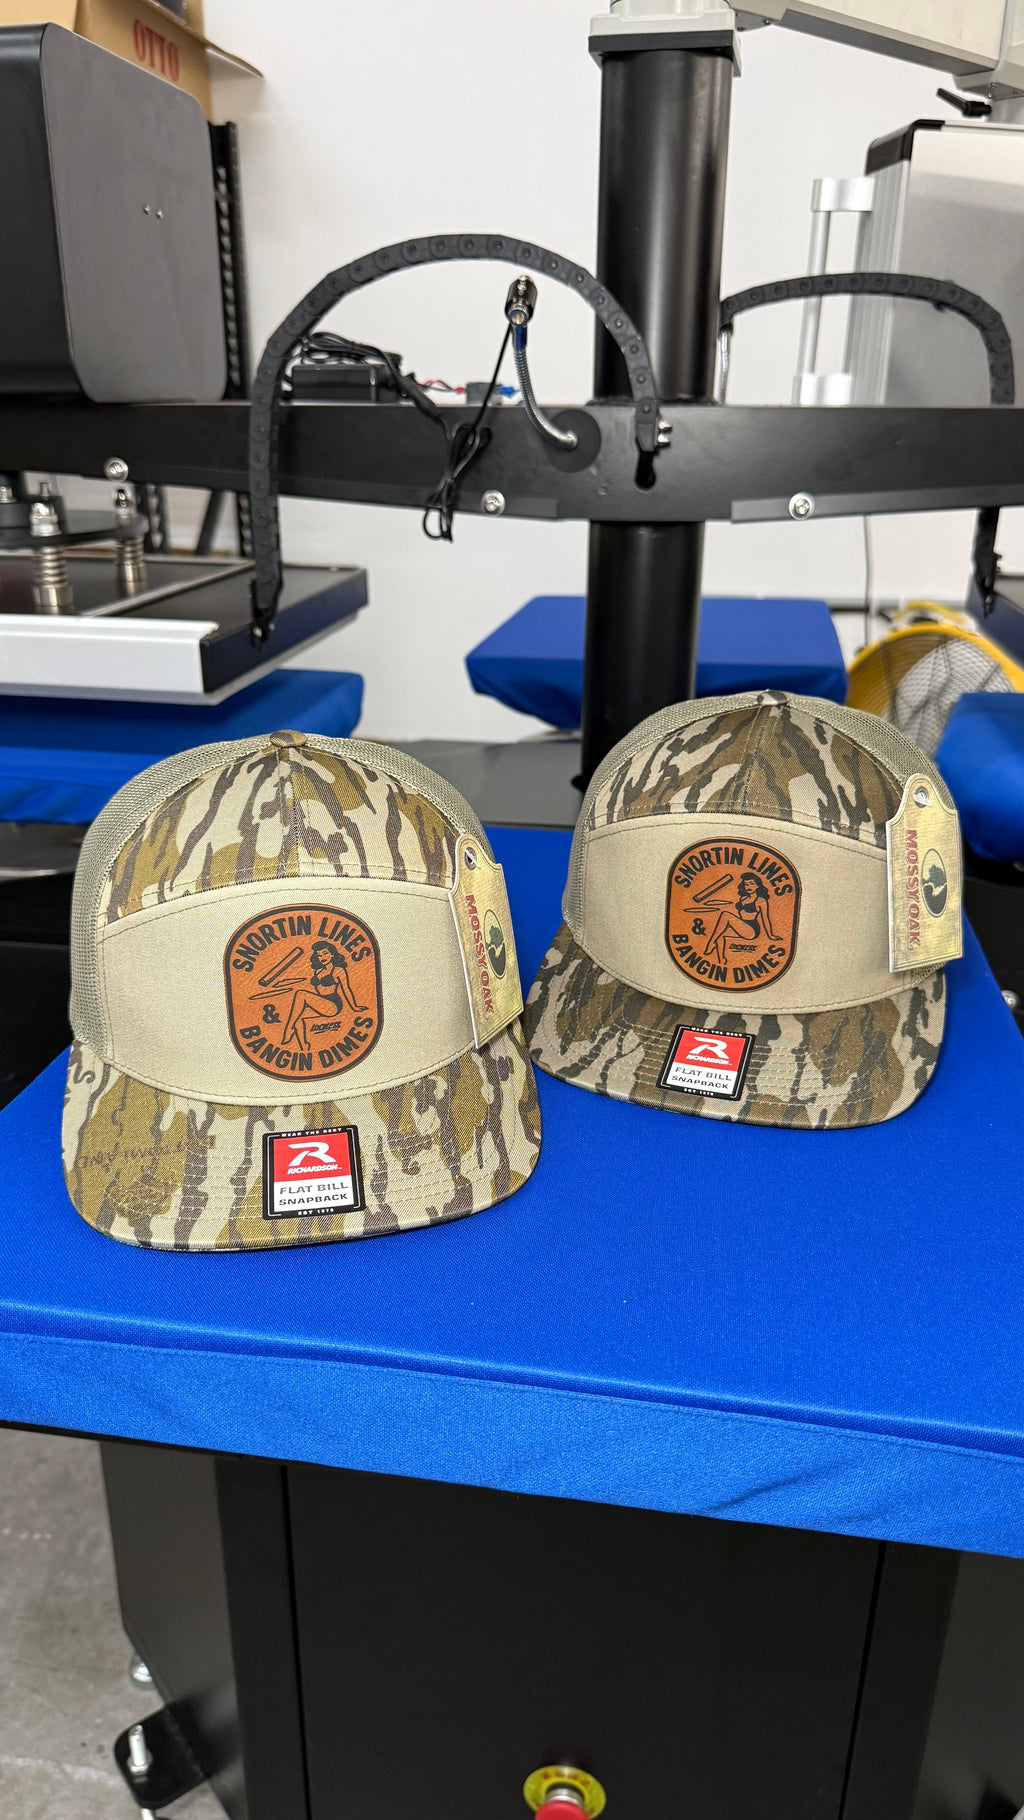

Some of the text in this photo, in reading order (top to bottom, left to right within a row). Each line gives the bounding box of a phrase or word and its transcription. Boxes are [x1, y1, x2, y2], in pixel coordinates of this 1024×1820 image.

[134, 19, 180, 82] OTTO
[674, 847, 793, 897] SNORTIN LINES
[905, 829, 921, 946] MOSSY OAK
[691, 918, 706, 937] &
[232, 915, 372, 973] SNORTIN LINES
[465, 894, 494, 1013] MOSSY OAK
[672, 934, 786, 984] BANGIN DIMES
[262, 1003, 281, 1025] &
[239, 1016, 374, 1071] BANGIN DIMES
[686, 1054, 730, 1065] RICHARDSON
[671, 1075, 729, 1089] SNAPBACK
[674, 1067, 732, 1081] FLAT BILL
[287, 1164, 338, 1175] RICHARDSON
[278, 1193, 348, 1206] SNAPBACK
[279, 1182, 349, 1195] FLAT BILL
